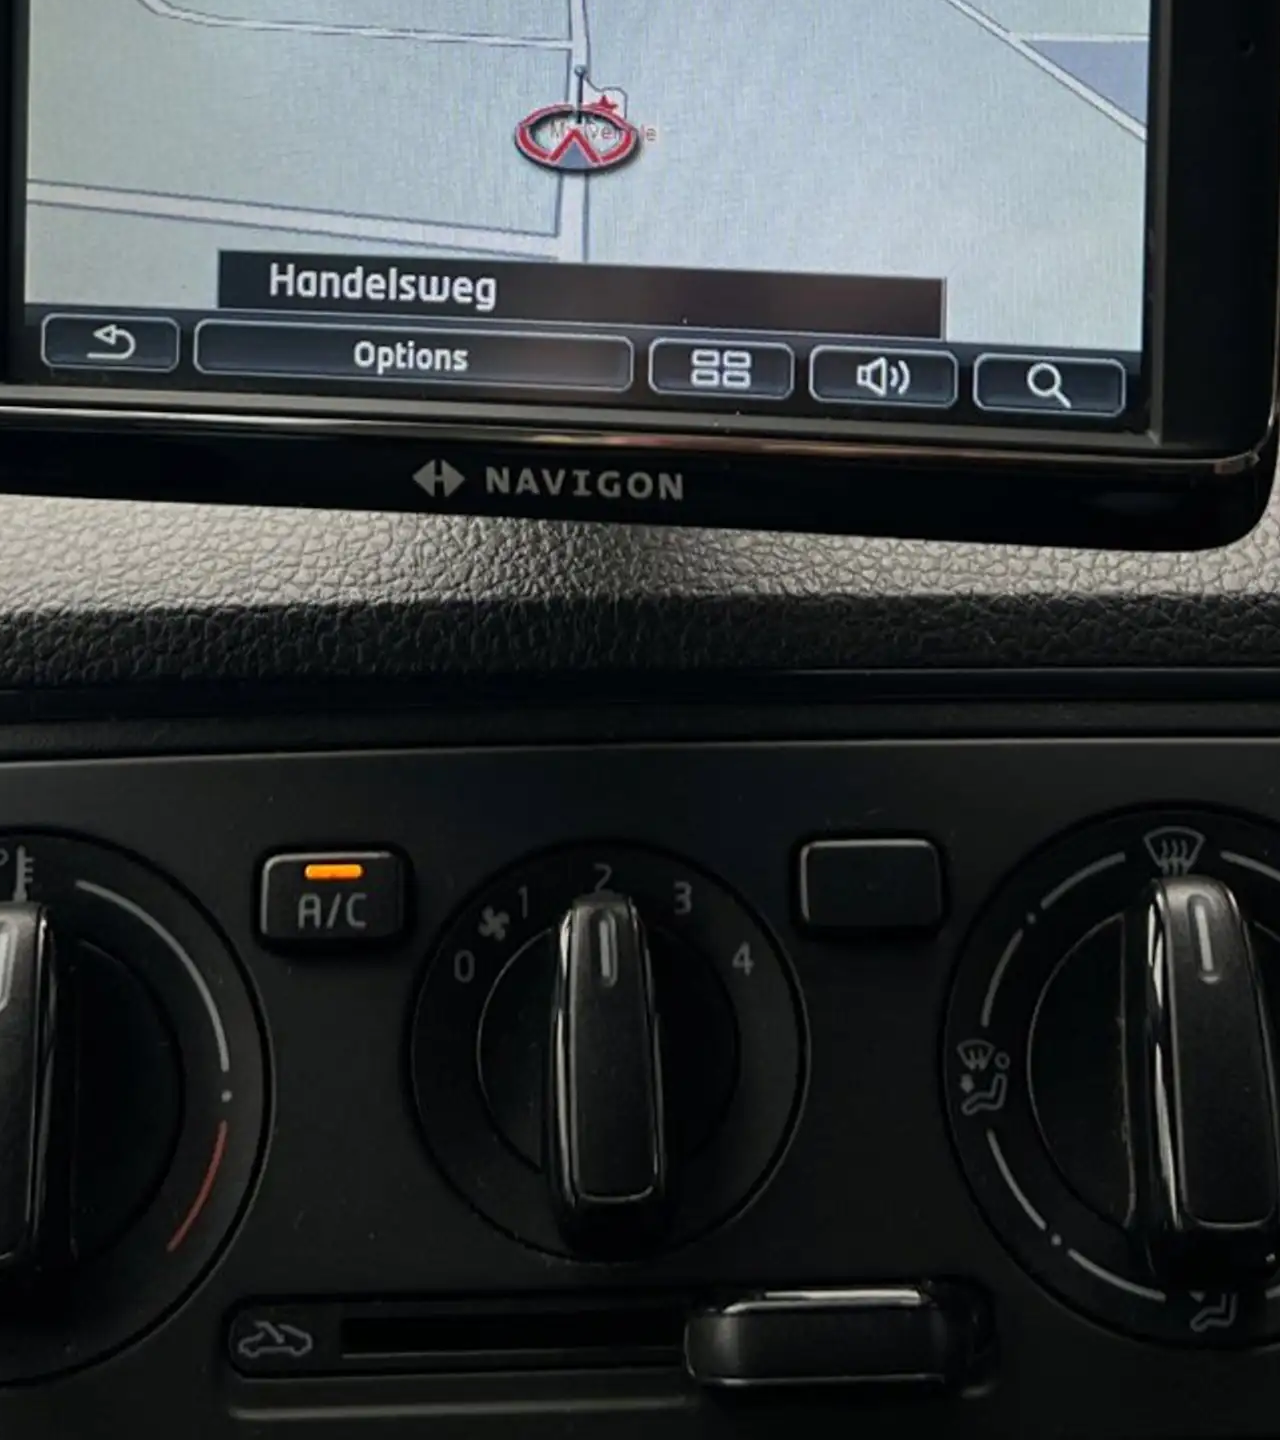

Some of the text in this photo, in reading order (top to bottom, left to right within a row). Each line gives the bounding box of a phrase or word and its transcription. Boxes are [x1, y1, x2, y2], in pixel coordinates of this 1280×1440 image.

[269, 262, 497, 312] Handelsweg
[353, 339, 469, 376] Options
[485, 465, 684, 501] NAVIGON
[593, 862, 613, 893] 2
[297, 892, 367, 930] A/C
[518, 885, 529, 920] 1
[673, 880, 693, 915] 3
[731, 940, 754, 977] 4
